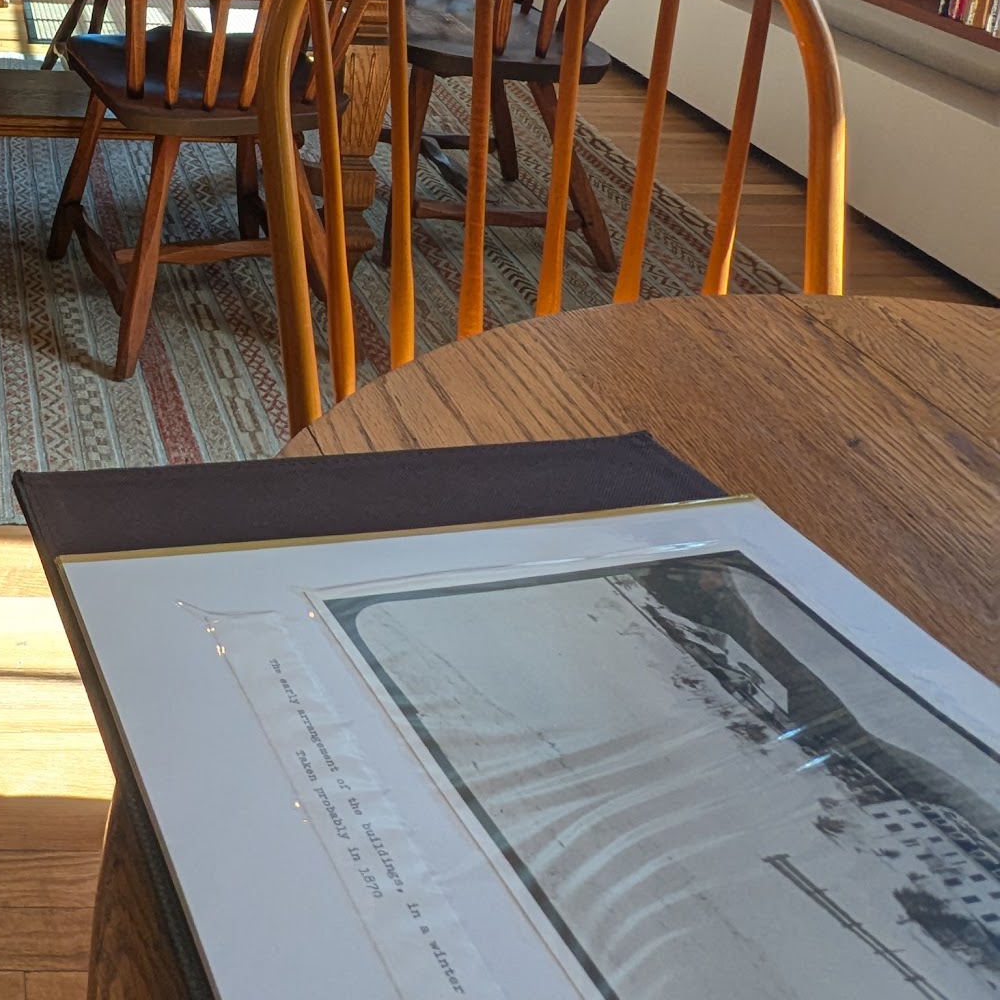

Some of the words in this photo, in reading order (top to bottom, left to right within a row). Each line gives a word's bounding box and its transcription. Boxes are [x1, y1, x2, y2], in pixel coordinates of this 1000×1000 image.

[268, 657, 282, 675] The
[279, 677, 301, 705] early
[296, 708, 340, 775] arrangement
[336, 777, 352, 793] of
[347, 796, 363, 818] the
[361, 821, 405, 894] buildings,
[405, 901, 422, 921] in
[420, 924, 431, 935] a
[428, 938, 466, 995] winter
[294, 749, 319, 783] Taken
[313, 785, 352, 841] probably
[346, 846, 362, 863] in
[357, 866, 384, 900] 1870
